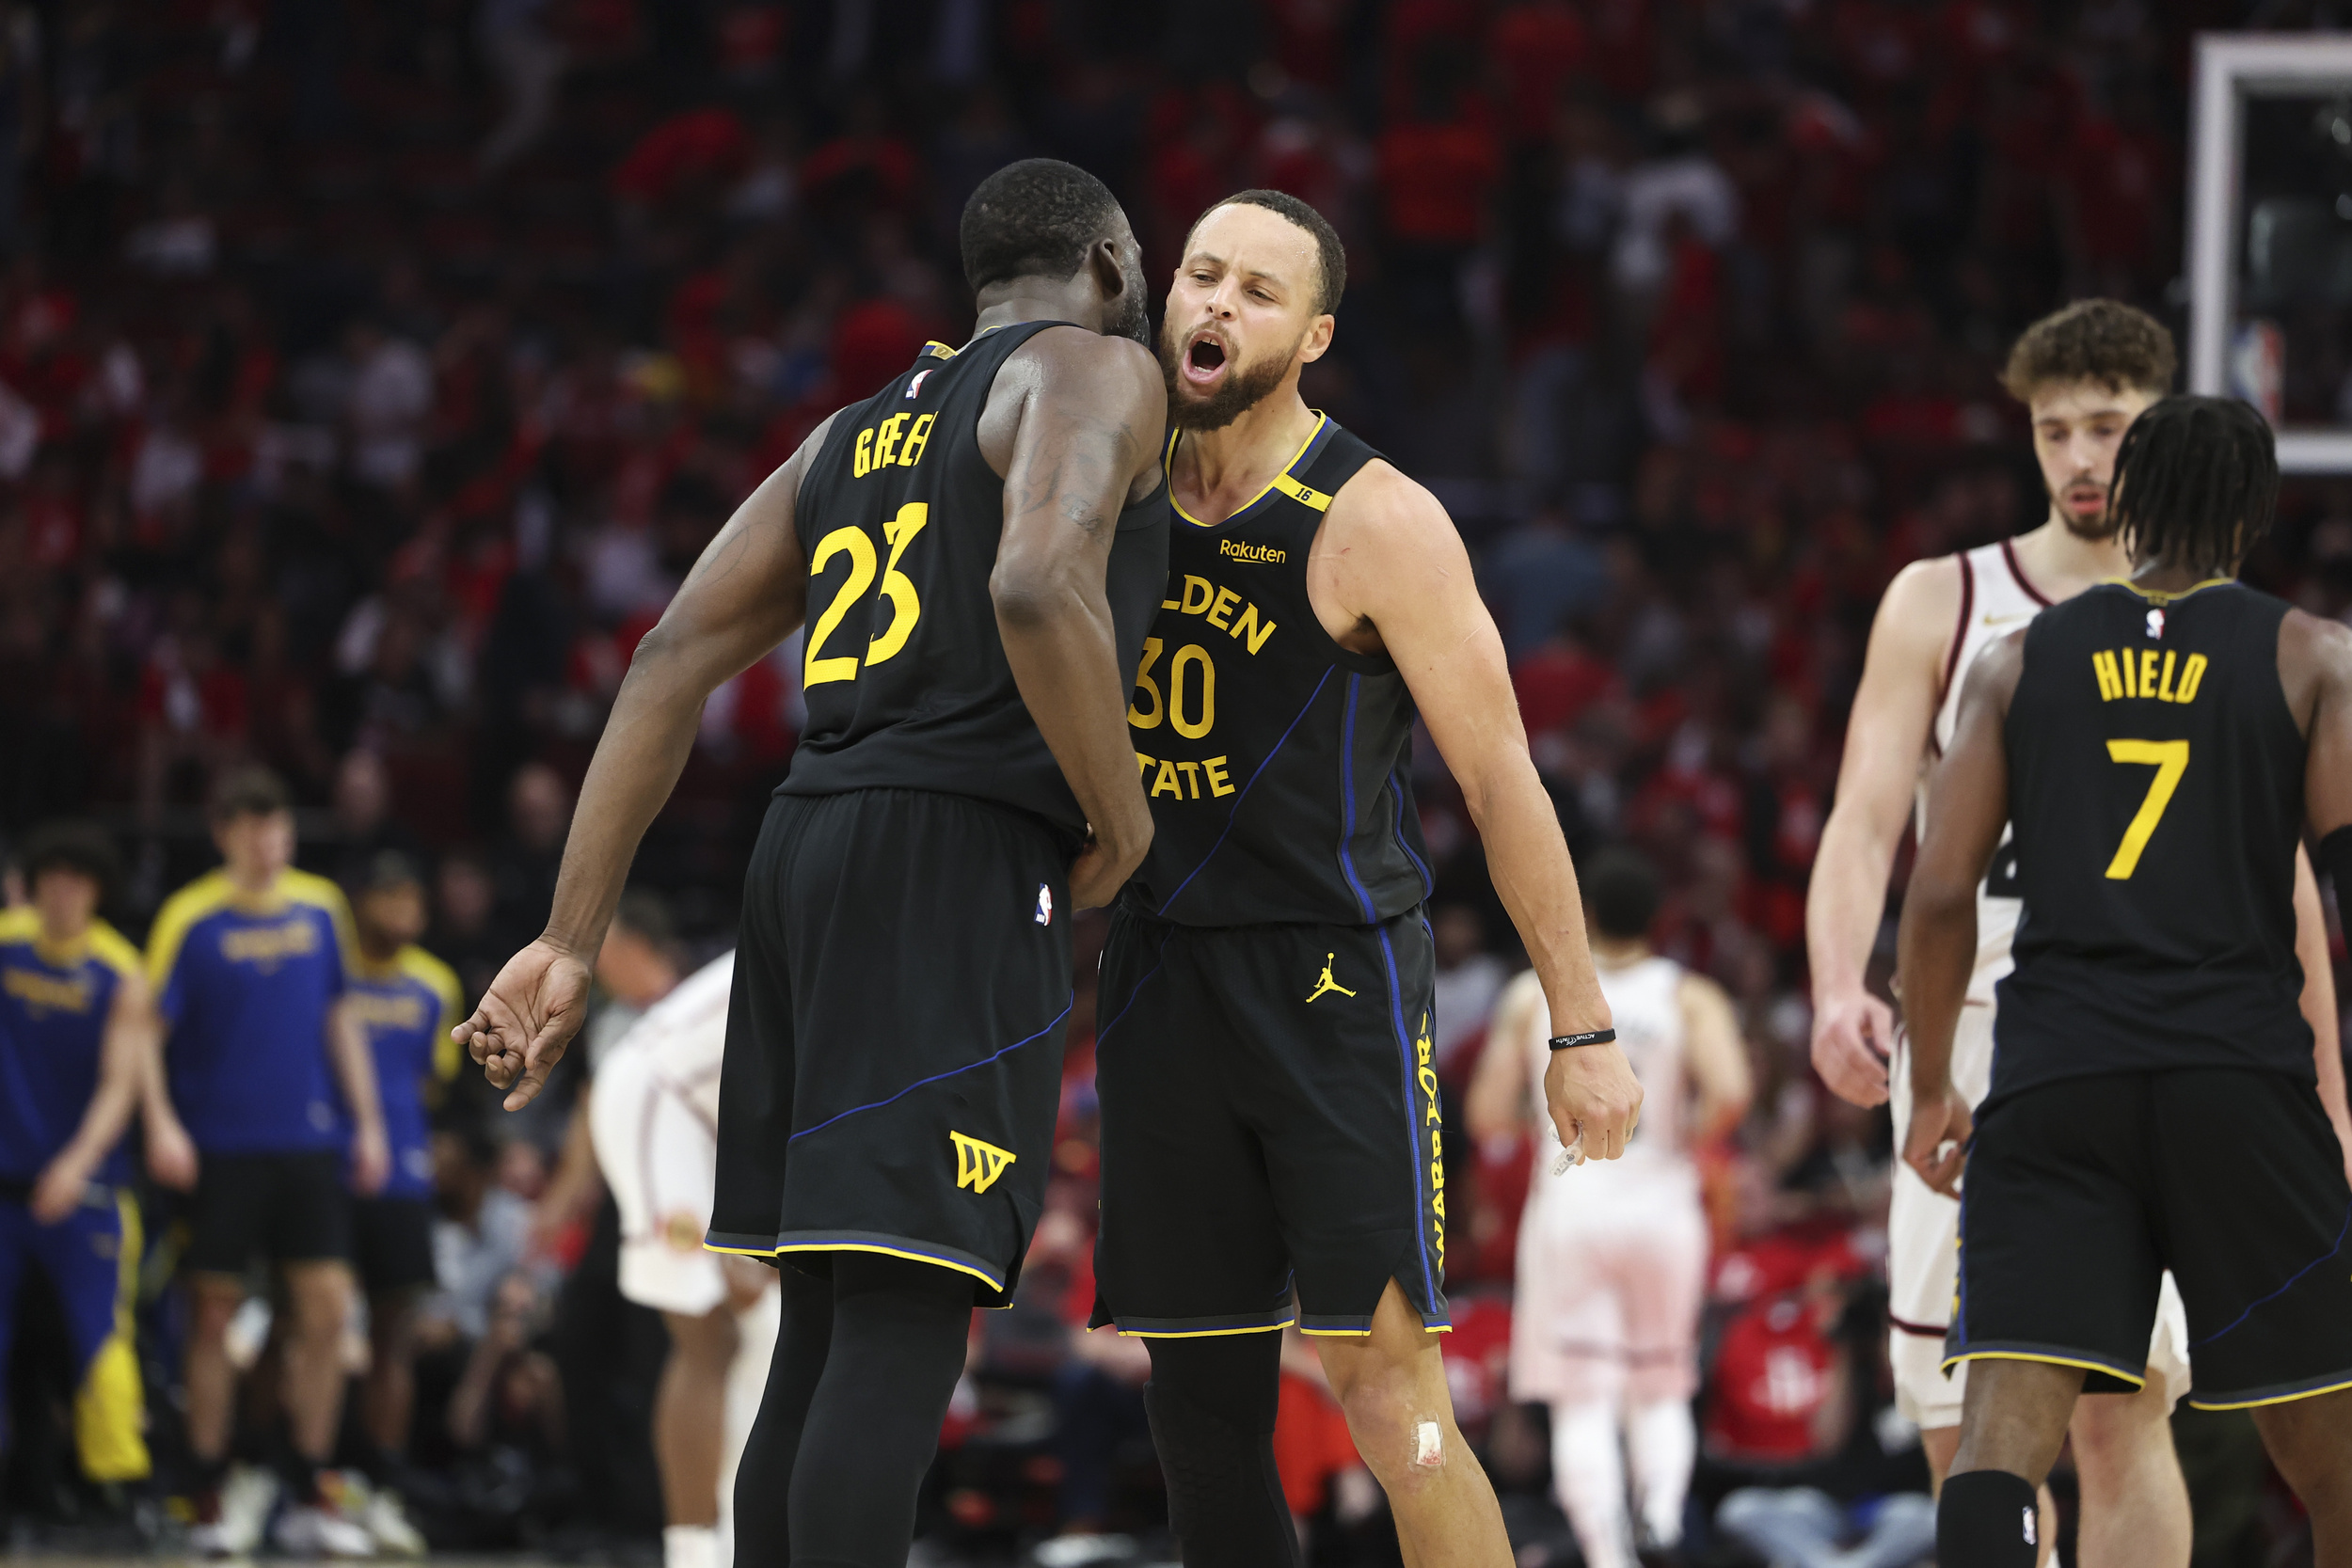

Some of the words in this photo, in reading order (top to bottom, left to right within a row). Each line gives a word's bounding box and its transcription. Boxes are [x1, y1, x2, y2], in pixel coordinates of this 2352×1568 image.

[853, 411, 939, 479] GREE
[1295, 487, 1313, 501] 16
[1219, 539, 1286, 563] Rakuten
[804, 502, 928, 691] 23
[1127, 637, 1215, 739] 30
[2092, 647, 2208, 704] HIELD
[1135, 752, 1235, 800] TATE
[2105, 738, 2190, 880] 7
[1417, 1011, 1446, 1273] WARRIOR
